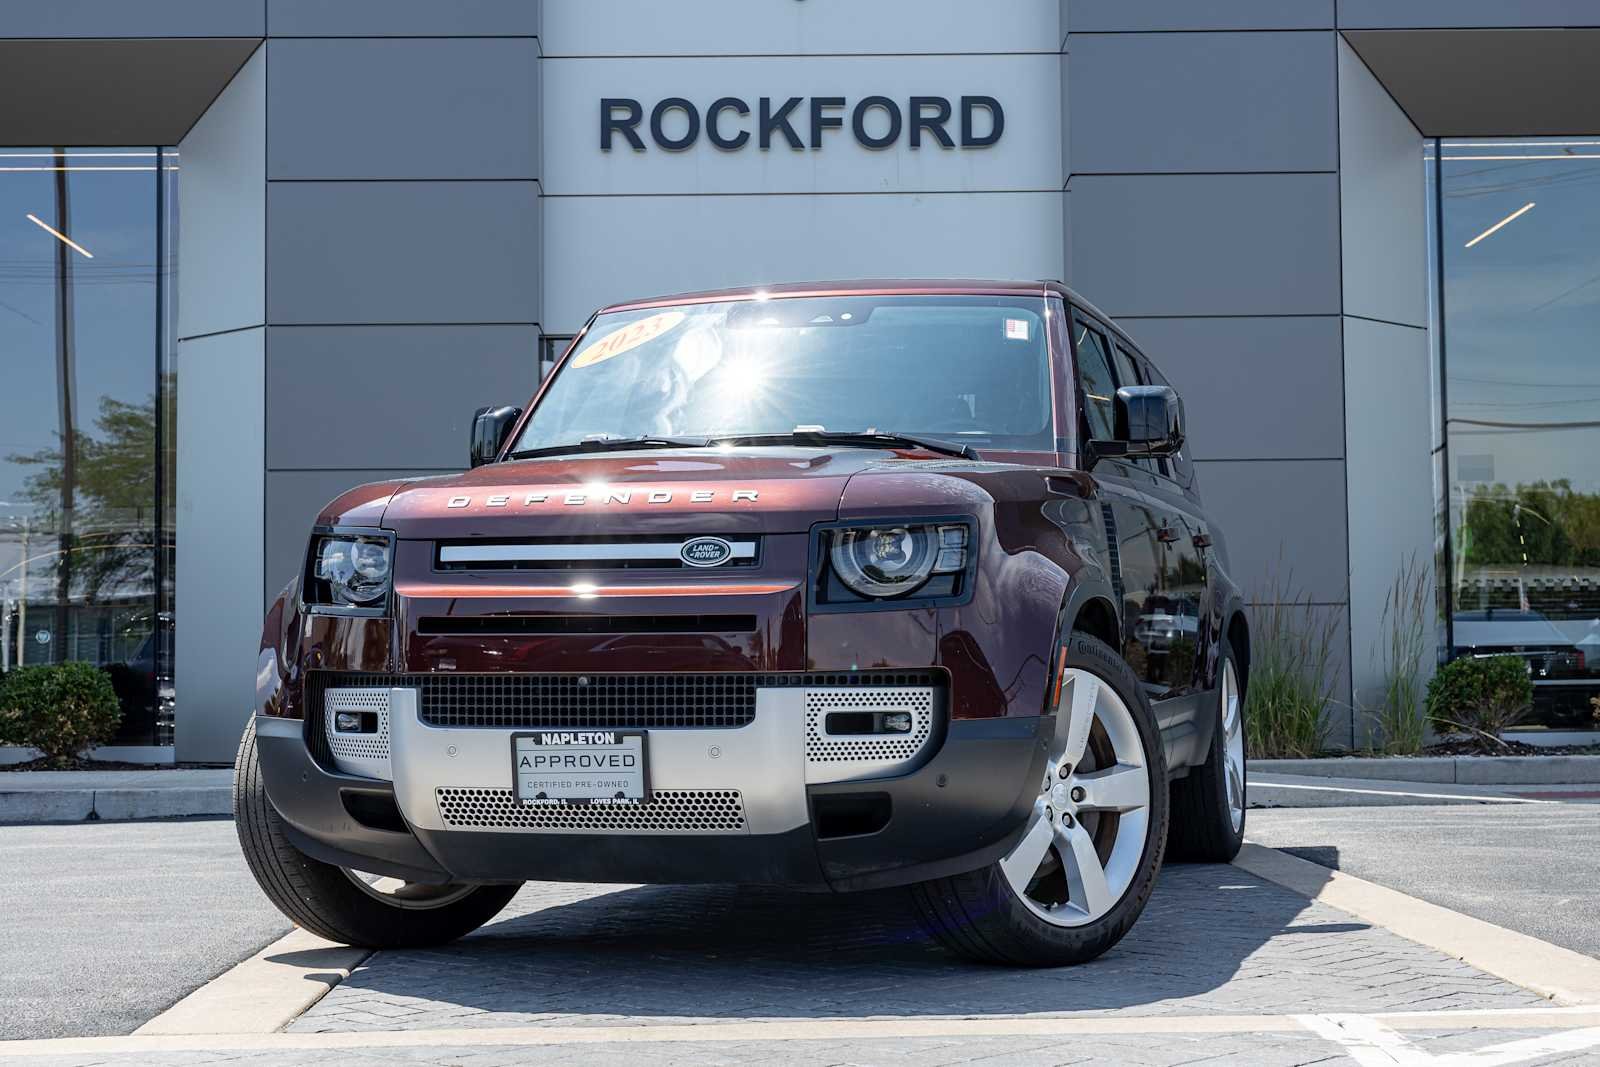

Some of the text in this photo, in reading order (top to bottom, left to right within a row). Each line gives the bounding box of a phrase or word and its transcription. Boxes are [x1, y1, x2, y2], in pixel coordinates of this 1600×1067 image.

[600, 96, 1006, 153] ROCKFORD
[447, 489, 760, 508] DEFENDER
[692, 544, 716, 552] LAND
[693, 551, 720, 559] ROVER
[541, 732, 615, 745] NAPLETON
[520, 755, 635, 768] APPROVED
[527, 780, 629, 789] CERTIFIED PRE-OWNED
[632, 797, 640, 805] IL
